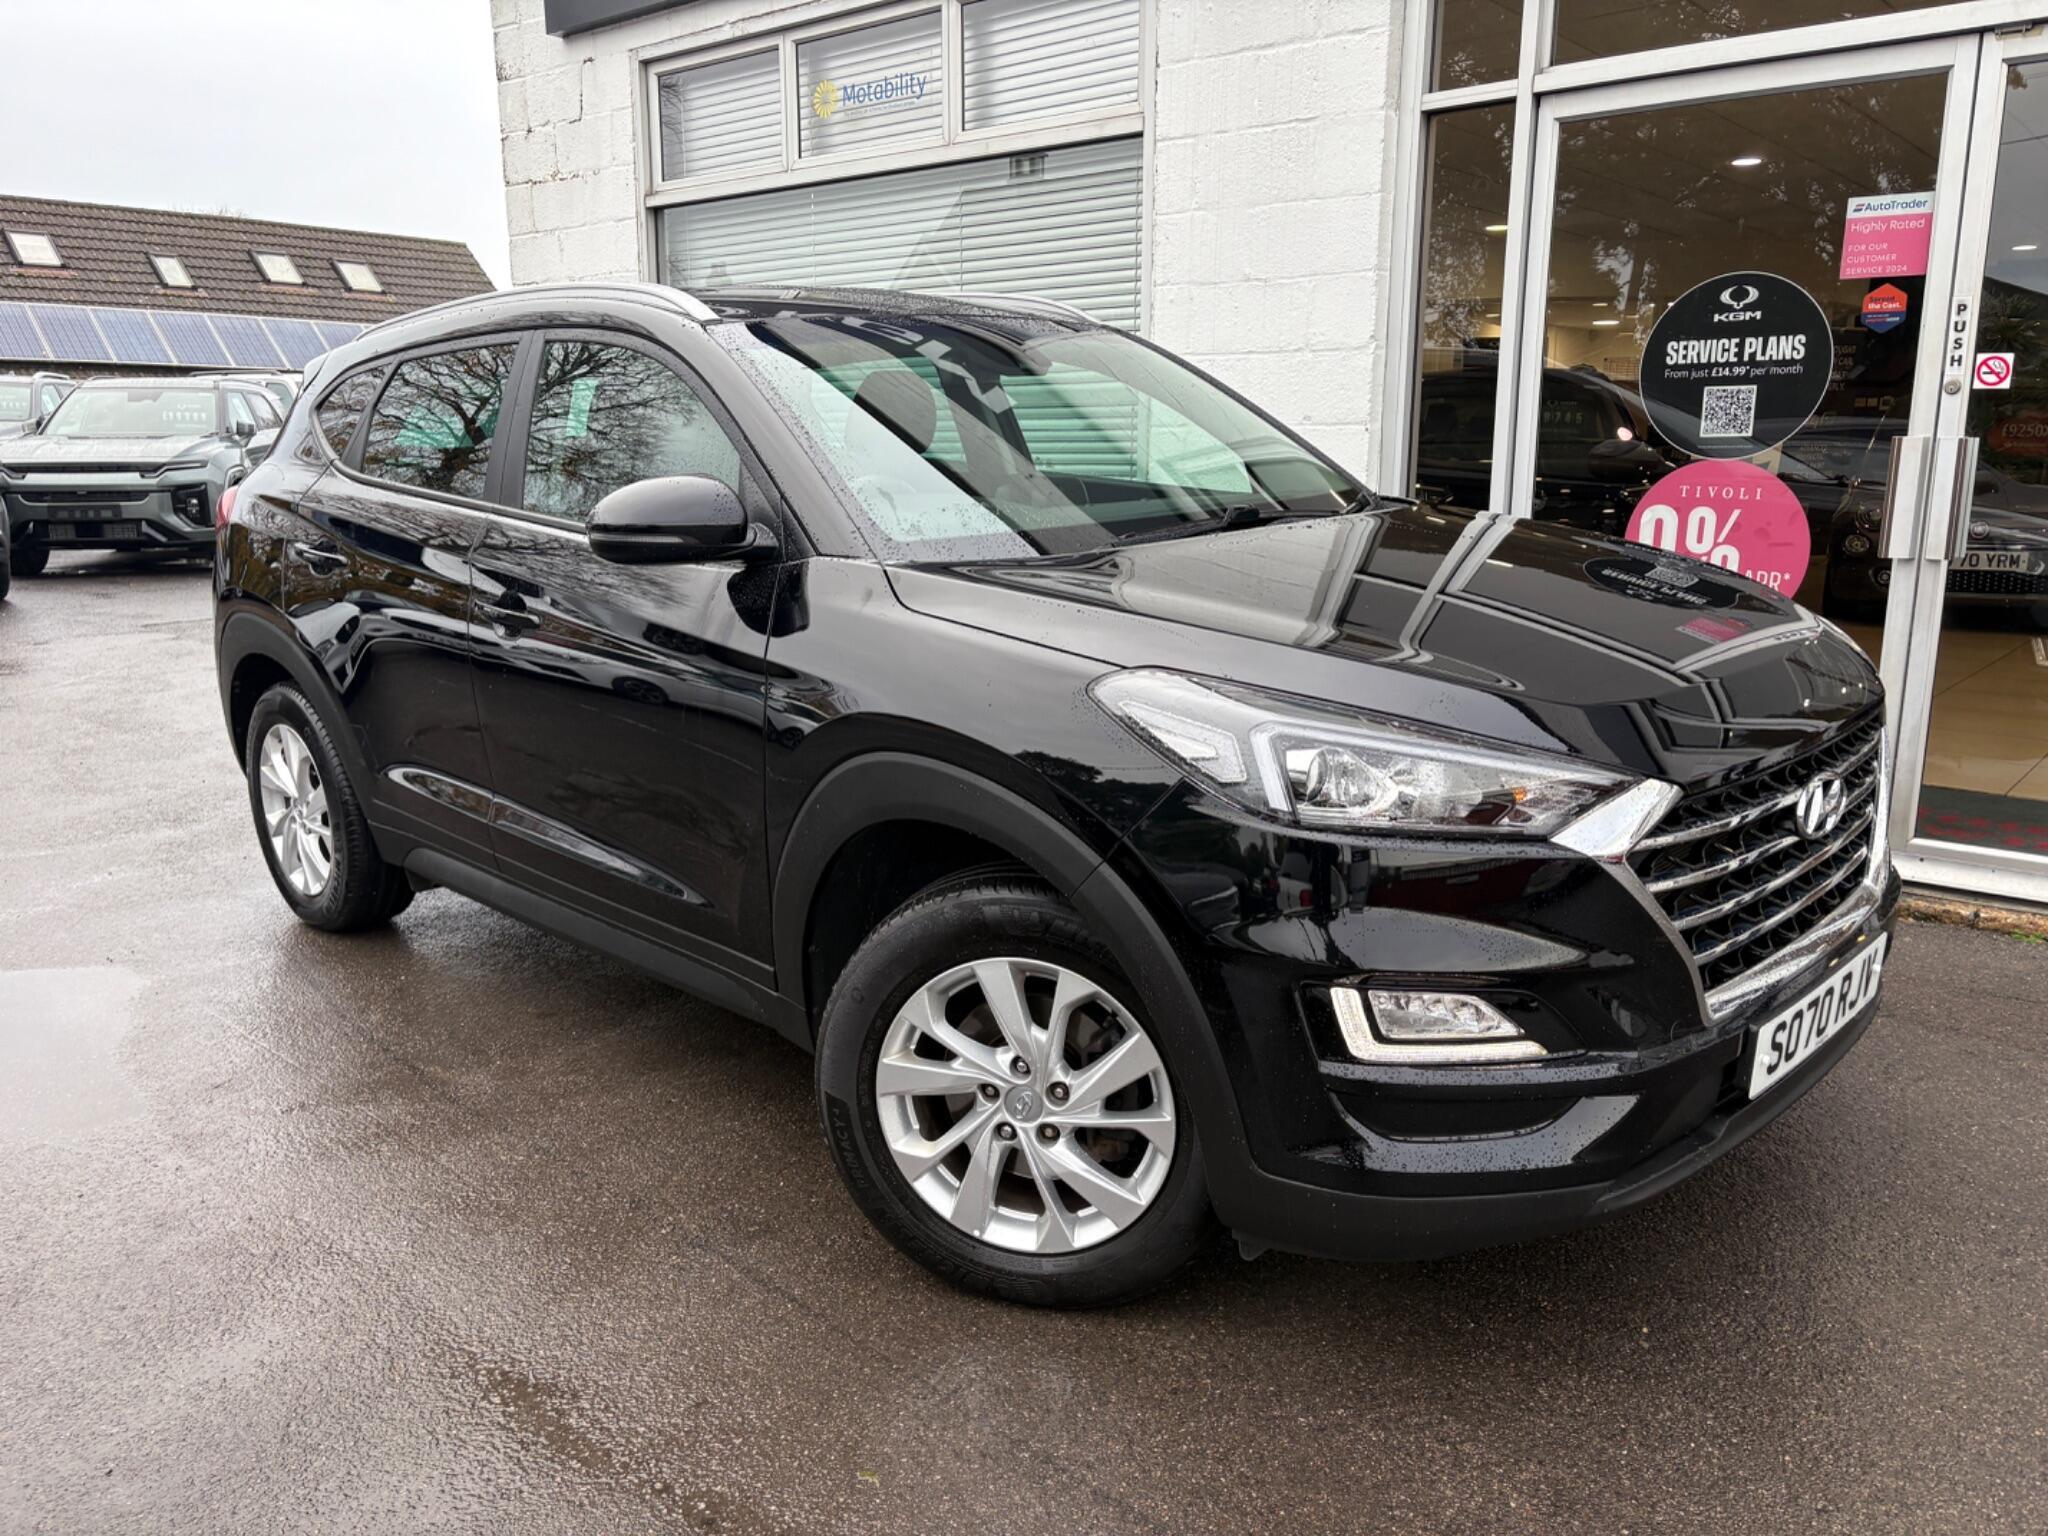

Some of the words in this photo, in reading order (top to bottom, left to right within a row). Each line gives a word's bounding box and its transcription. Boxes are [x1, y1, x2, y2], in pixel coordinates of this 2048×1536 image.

[842, 73, 927, 106] Motability
[1864, 199, 1928, 212] AutoTrader
[1850, 220, 1887, 234] Highly
[1890, 217, 1925, 230] Rated
[1848, 244, 1866, 252] FOR
[1868, 242, 1888, 250] OUR
[1846, 253, 1897, 263] CUSTOMER
[1845, 266, 1883, 275] SERVICE
[1885, 264, 1907, 273] 2024
[1713, 311, 1762, 322] KGM
[1950, 303, 1968, 367] PUSH
[1665, 338, 1740, 365] SERVICE
[1743, 334, 1806, 362] PLANS
[1664, 369, 1689, 379] From
[1690, 368, 1709, 380] just
[1750, 367, 1767, 378] per
[1769, 363, 1804, 375] month
[1680, 485, 1762, 500] TIVOLI
[1986, 553, 2021, 568] YRM
[1766, 985, 1835, 1075] SO70
